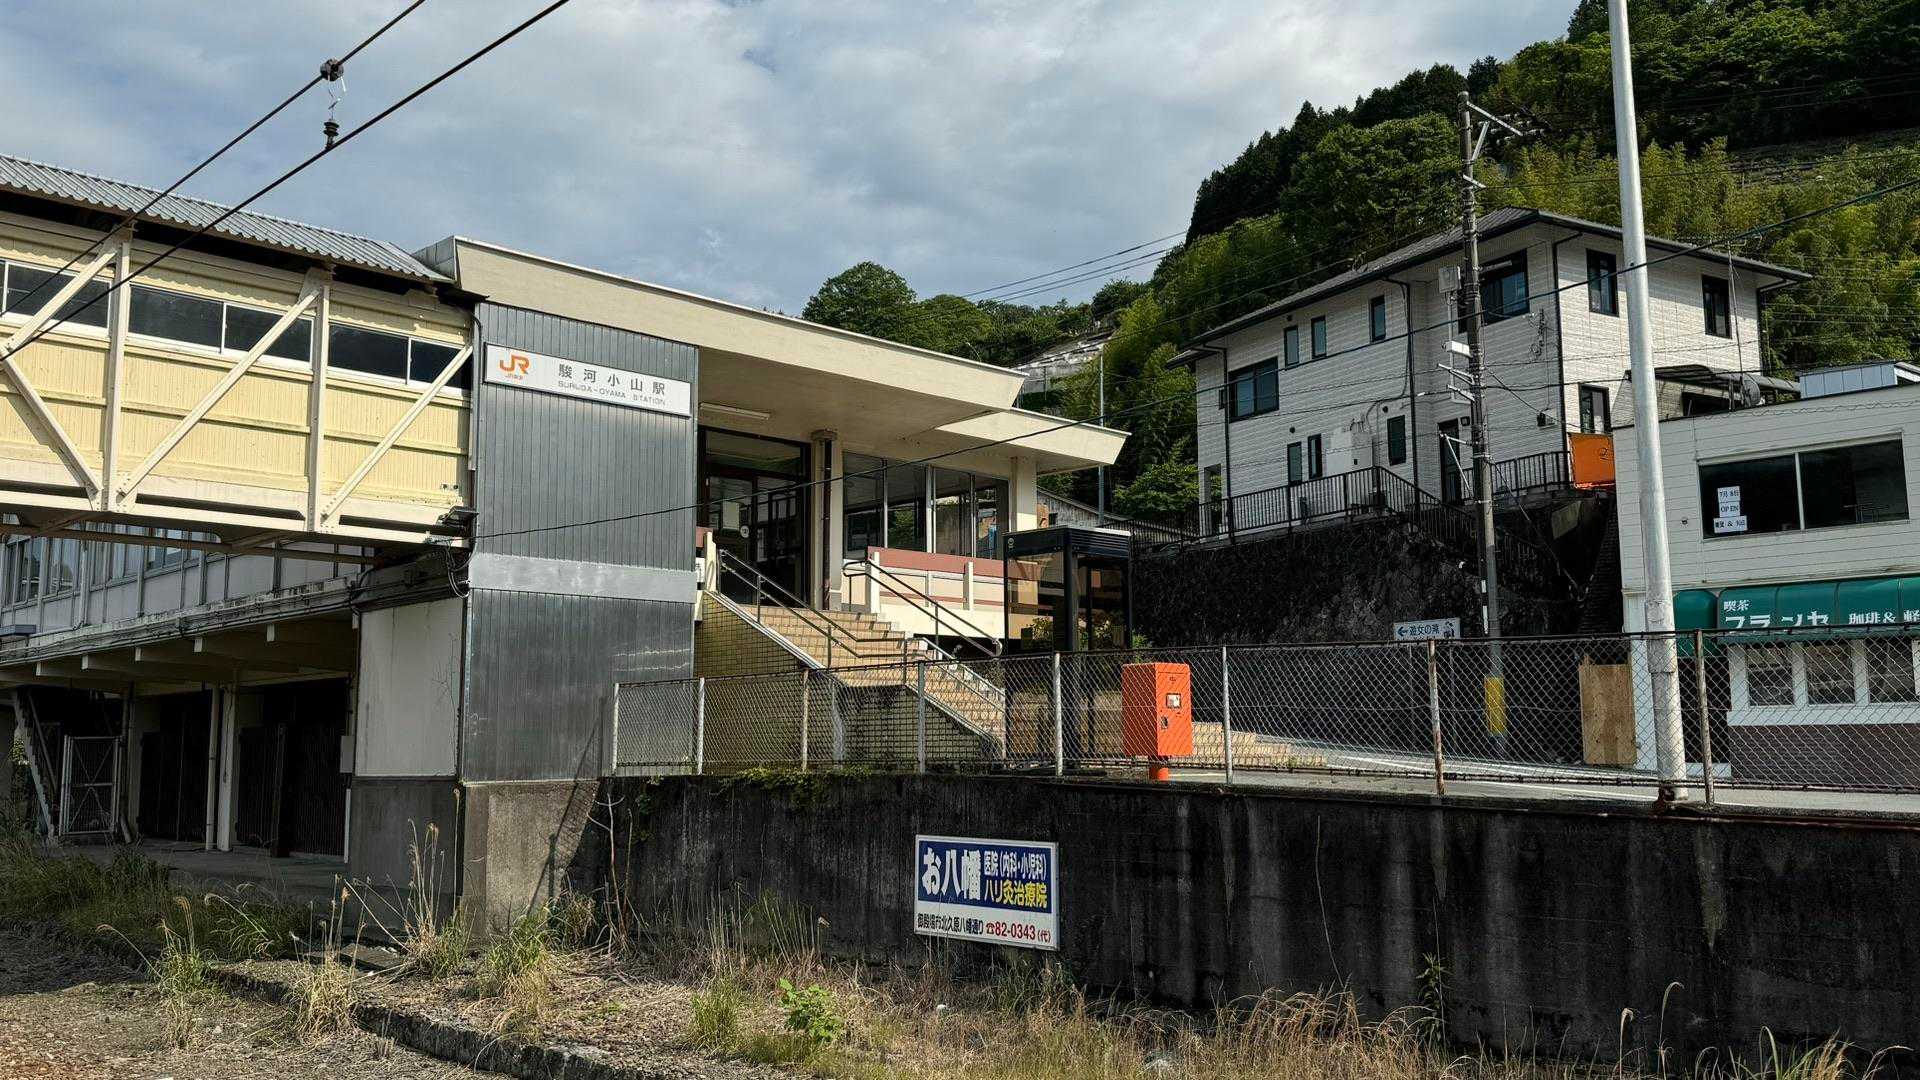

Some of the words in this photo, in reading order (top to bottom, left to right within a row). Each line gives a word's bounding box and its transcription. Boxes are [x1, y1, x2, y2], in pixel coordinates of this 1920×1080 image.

[500, 354, 529, 375] JR
[558, 364, 665, 396] 駿河小山駅
[1723, 599, 1749, 612] 喫茶
[922, 847, 981, 900] お八幡
[984, 879, 1048, 909] ハリ灸治療院
[995, 921, 1036, 940] 82-0343
